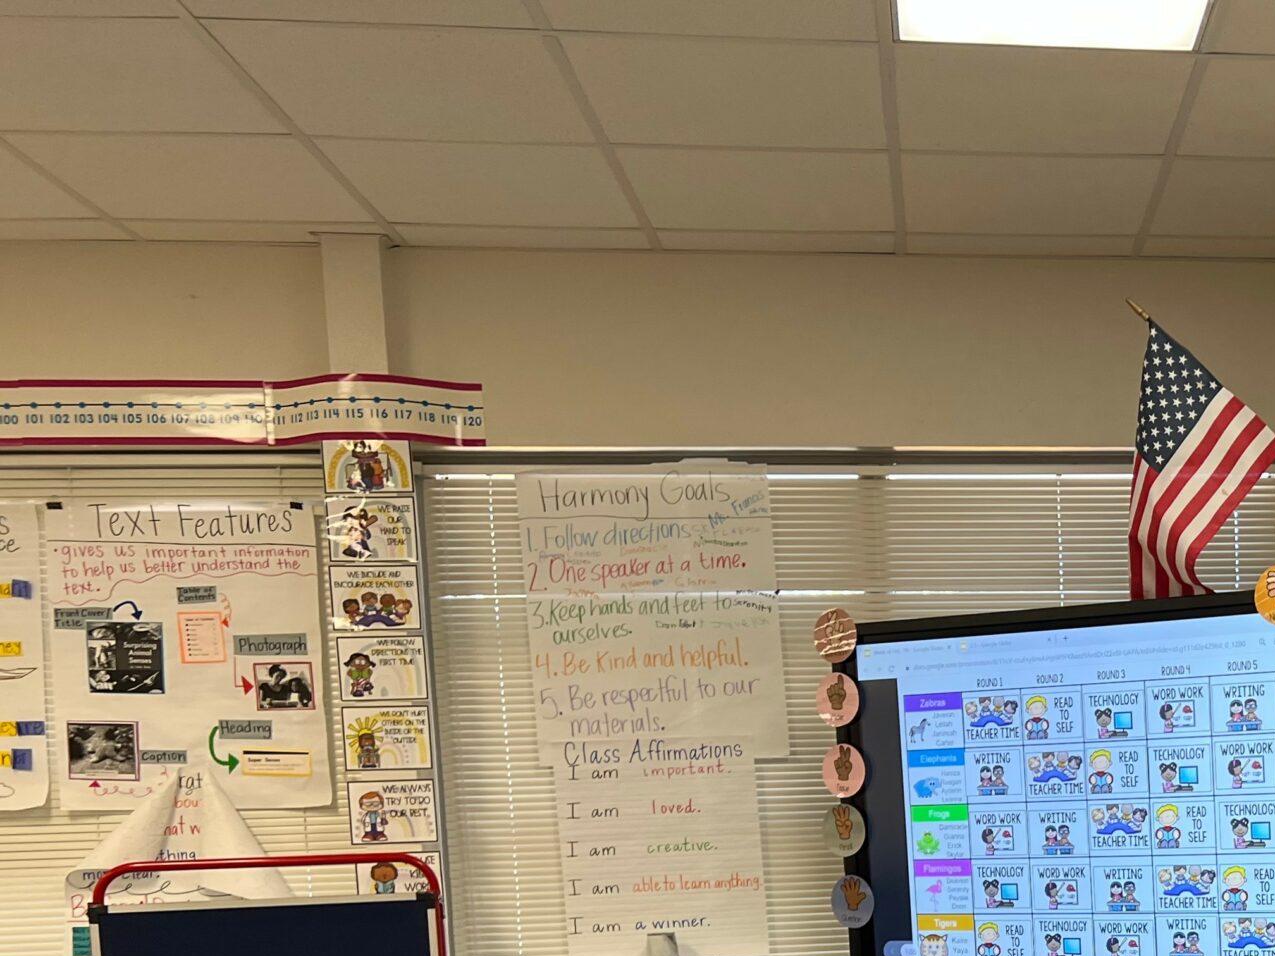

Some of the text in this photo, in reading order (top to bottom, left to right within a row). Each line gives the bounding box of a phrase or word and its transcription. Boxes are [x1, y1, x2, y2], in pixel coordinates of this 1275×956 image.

[122, 408, 413, 424] 105 106 114 115 117
[538, 471, 730, 521] Harmony Goals
[88, 503, 293, 539] Text Features
[543, 524, 602, 551] Follow
[603, 520, 693, 546] directions
[61, 544, 310, 565] gives us important information
[63, 558, 300, 579] to help us better understand the
[549, 557, 586, 585] One
[590, 557, 650, 588] speaker
[656, 556, 674, 575] at
[680, 558, 690, 572] a
[699, 552, 747, 570] time.
[239, 637, 307, 655] Photograph
[562, 651, 591, 676] Be
[643, 645, 674, 668] and
[680, 636, 749, 670] helpful.
[568, 684, 596, 711] Be
[602, 675, 689, 713] respectful
[697, 677, 716, 698] to
[723, 677, 760, 697] our
[1088, 693, 1140, 707] TECHNOLOGY
[1151, 686, 1204, 700] WORD WORK
[1223, 684, 1265, 698] WRITING
[1053, 696, 1073, 709] READ
[571, 708, 666, 737] materials.
[1060, 709, 1070, 720] TO
[220, 721, 272, 738] Heading
[966, 727, 1020, 740] TEACHER TIME
[1056, 721, 1074, 734] SELF
[141, 752, 187, 762] Caption
[564, 738, 744, 766] Class Affirmations
[591, 768, 619, 779] am
[643, 760, 733, 780] important.
[568, 916, 711, 935] I am a winner.
